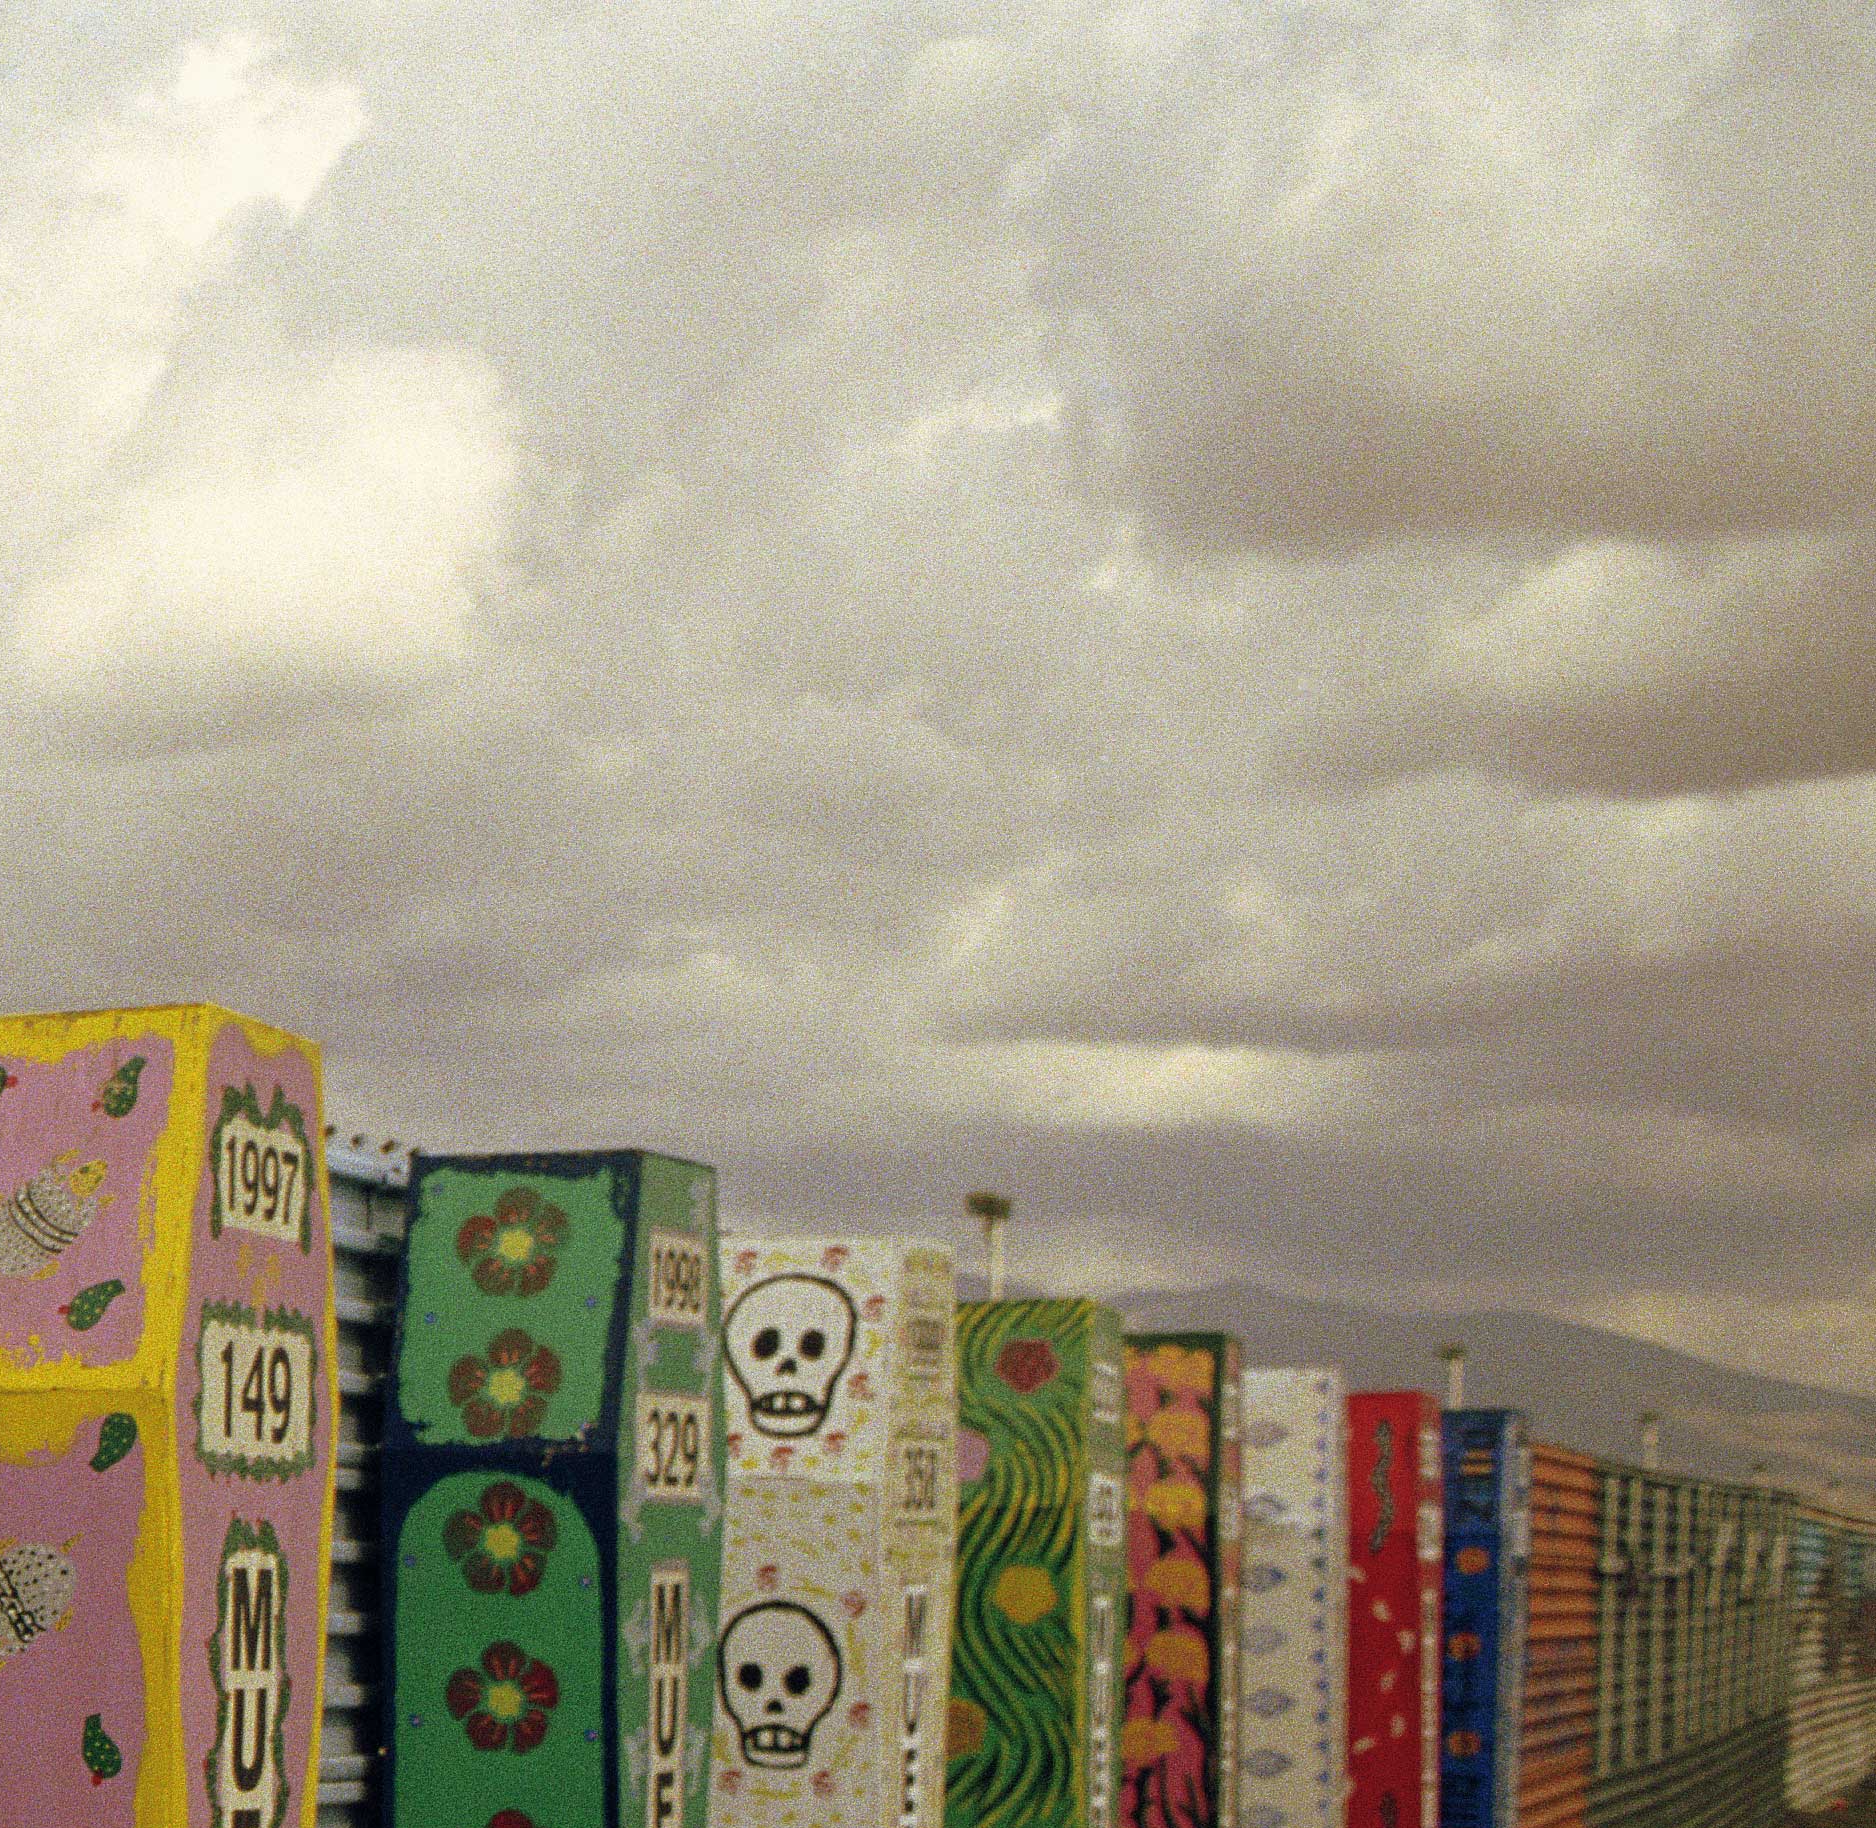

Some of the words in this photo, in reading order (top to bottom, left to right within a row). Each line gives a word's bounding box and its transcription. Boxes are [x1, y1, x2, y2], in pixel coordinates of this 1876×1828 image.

[226, 1136, 298, 1225] 1997
[220, 1340, 292, 1444] 149
[645, 1408, 699, 1486] 329
